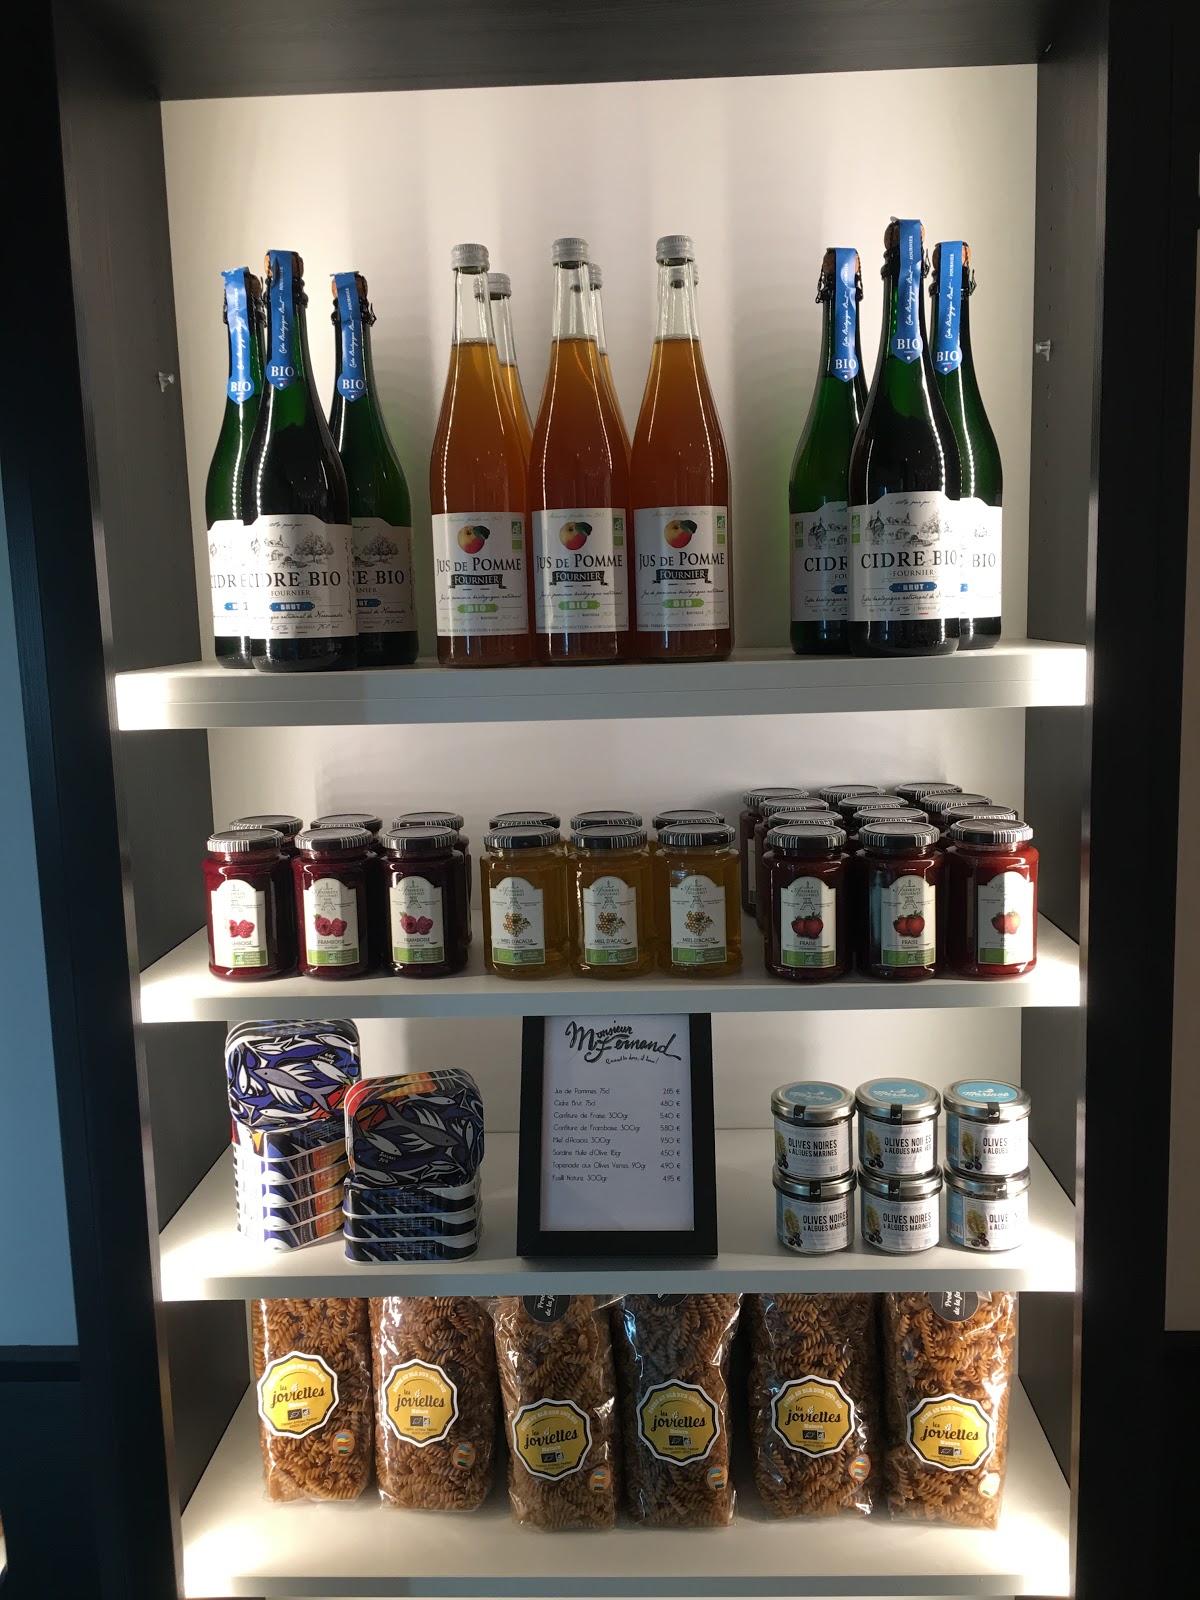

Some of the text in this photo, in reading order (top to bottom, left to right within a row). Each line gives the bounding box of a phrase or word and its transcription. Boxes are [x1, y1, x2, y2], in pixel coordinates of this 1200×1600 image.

[896, 338, 921, 350] BIO
[936, 350, 960, 362] BIO
[834, 358, 857, 370] BIO
[270, 366, 294, 377] BIO
[230, 381, 252, 392] BIO
[342, 379, 364, 390] BIO
[536, 553, 623, 572] JUS DE POMME
[639, 552, 725, 572] JUS DE POMME
[804, 556, 848, 572] CIDR
[860, 550, 958, 569] CIDRE BIO
[972, 553, 996, 568] BIO
[437, 556, 522, 576] JUS DE POMME
[308, 570, 342, 587] BIO
[375, 570, 405, 585] BIO
[555, 571, 601, 581] FOURNIER
[660, 570, 706, 580] FOURNIER
[892, 569, 935, 577] FOURNIER
[211, 574, 247, 589] IDRE
[454, 575, 500, 584] FOURNIER
[467, 604, 487, 612] BIO
[568, 600, 588, 609] BIO
[673, 599, 692, 607] BIO
[564, 1020, 633, 1051] Monsieur
[584, 1033, 682, 1063] Fernand
[608, 1112, 628, 1120] 300gr
[620, 1124, 640, 1132] 300gr
[552, 1136, 563, 1144] Miel
[591, 1136, 611, 1145] 300gr
[788, 1138, 838, 1150] OLIVES NOIRES
[884, 1134, 932, 1147] OLIVES NOIES
[983, 1138, 1008, 1146] OLIVES
[792, 1149, 812, 1157] ALGUES
[813, 1149, 838, 1158] MARINES
[632, 1162, 646, 1170] 90gr
[587, 1174, 607, 1183] 300gr
[803, 1210, 848, 1225] OLIVES NOIRES
[883, 1212, 932, 1224] OLIVES NOIRES
[989, 1214, 1008, 1223] OLIVE
[829, 1219, 849, 1231] MARINES
[910, 1222, 932, 1231] MARINES
[944, 1291, 952, 1307] Prod
[953, 1307, 960, 1315] de
